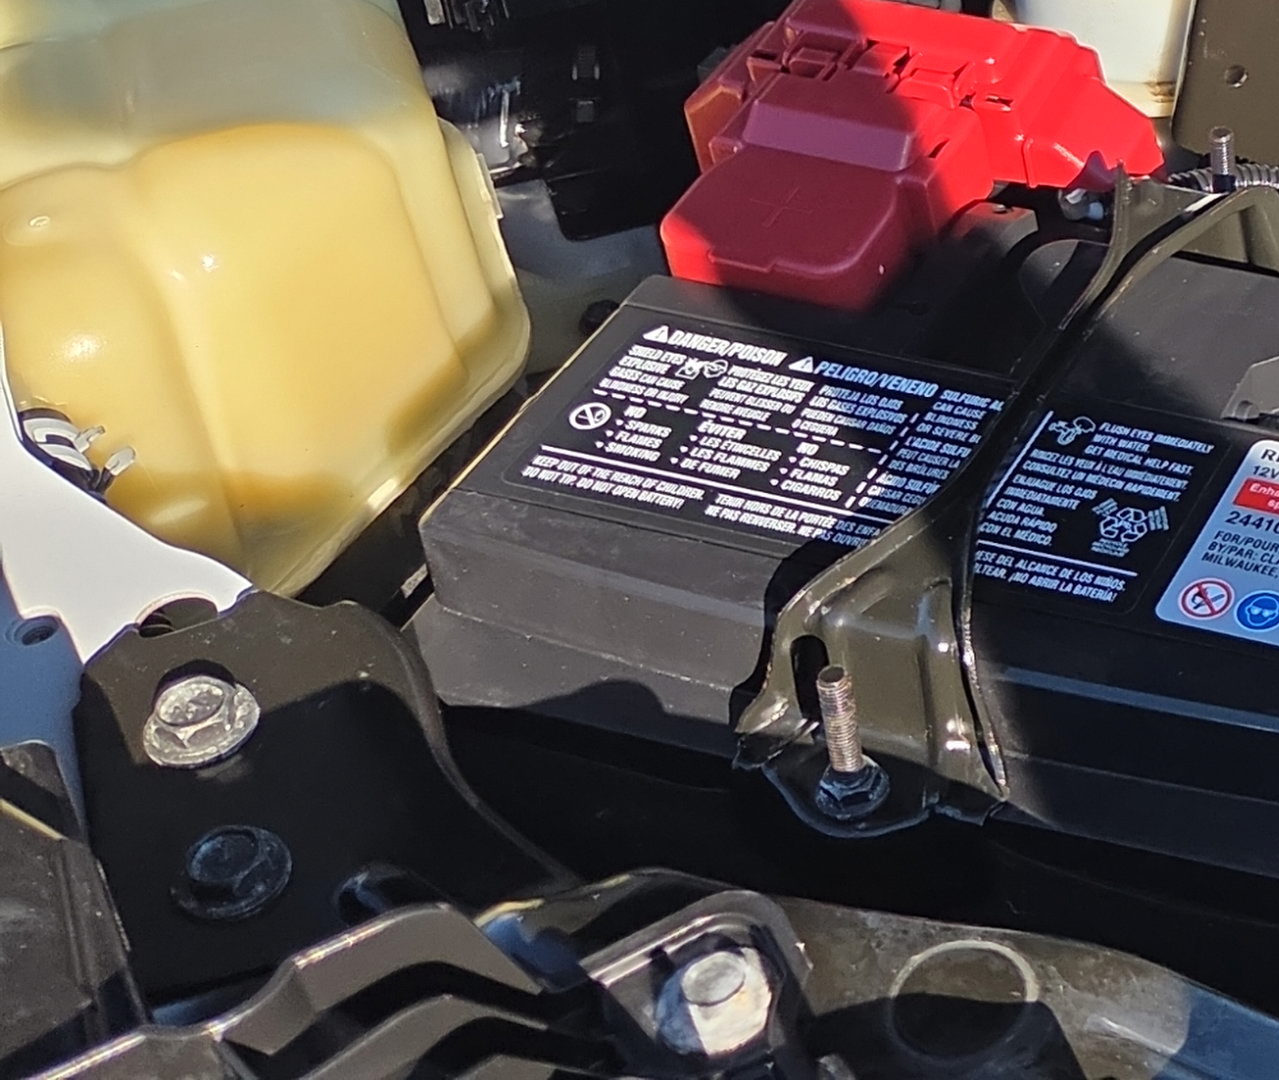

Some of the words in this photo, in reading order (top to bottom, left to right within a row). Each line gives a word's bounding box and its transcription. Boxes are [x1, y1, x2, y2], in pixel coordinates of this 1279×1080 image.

[627, 346, 662, 359] SHIELD
[665, 332, 785, 365] DANGER/POISON
[813, 362, 937, 397] PELIGRO/VENENO
[819, 385, 861, 400] PROTEJA
[859, 393, 879, 404] LOS
[878, 396, 902, 409] OJOS
[940, 390, 989, 407] SULFURIC
[623, 406, 646, 418] NO
[800, 407, 835, 421] PUEDEN
[834, 414, 868, 428] CAUSAR
[809, 396, 828, 407] LOS
[827, 400, 856, 412] GASES
[855, 405, 907, 423] EXPLOSIVOS
[933, 401, 953, 411] CAN
[954, 405, 984, 418] CAUSE
[624, 420, 672, 436] SPARKS
[697, 420, 747, 438] ÉVITER
[800, 421, 838, 435] CEGUERA
[924, 412, 977, 429] BLINDNESS
[614, 432, 662, 447] FLAMES
[916, 422, 932, 432] OR
[932, 426, 968, 440] SEVERE
[1092, 434, 1117, 446] WITH
[1098, 423, 1130, 436] FLUSH
[1129, 429, 1154, 440] EYES
[1152, 434, 1214, 452] IMMEDIATELY
[699, 434, 722, 447] LES
[796, 442, 819, 454] NO
[603, 442, 660, 460] SMOKING
[690, 447, 713, 459] LES
[712, 452, 770, 471] FLAMMES
[896, 448, 918, 459] PEUT
[917, 452, 948, 465] CAUSER
[948, 459, 960, 468] LA
[1084, 445, 1103, 456] GET
[1102, 449, 1144, 464] MEDICAL
[1143, 457, 1169, 469] HELP
[532, 455, 559, 467] KEEP
[556, 460, 579, 472] OUT
[576, 464, 593, 475] OF
[590, 468, 612, 479] THE
[609, 472, 644, 486] REACH
[641, 478, 657, 488] OF
[681, 459, 698, 469] DE
[697, 462, 740, 478] FUMER
[797, 457, 848, 474] CHISPAS
[1029, 450, 1059, 462] RINCEZ
[1057, 455, 1074, 465] LES
[1073, 458, 1095, 469] YEUX
[1101, 464, 1125, 475] L'EAU
[789, 468, 837, 485] FLAMAS
[1021, 461, 1072, 478] CONSULTEZ
[1070, 470, 1086, 481] UN
[1084, 473, 1125, 488] MÉDECIN
[521, 466, 540, 477] DO
[536, 470, 560, 481] NOT
[574, 478, 593, 488] DO
[590, 481, 613, 493] NOT
[610, 485, 640, 498] OPEN
[637, 491, 684, 508] BATTERY!
[780, 480, 841, 499] CIGARROS
[866, 484, 903, 500] CAUSAR
[1012, 475, 1056, 490] ENJUAGUE
[1056, 483, 1074, 494] LOS
[1073, 486, 1097, 498] OJOS
[713, 492, 745, 508] TENIR
[742, 499, 772, 514] HORS
[770, 504, 786, 517] DE
[784, 507, 800, 520] LA
[835, 518, 856, 532] DES
[996, 499, 1017, 509] CON
[704, 504, 721, 516] NE
[719, 508, 740, 520] PAS
[796, 524, 813, 536] NE
[812, 527, 833, 540] PAS
[987, 509, 1021, 524] ACUDA
[979, 522, 1001, 534] CON
[1000, 526, 1014, 536] EL
[1207, 541, 1260, 560] BY/PAR:
[994, 555, 1015, 567] DEL
[1014, 559, 1060, 576] ALCANCE
[1058, 567, 1074, 578] DE
[1072, 570, 1095, 582] LOS
[1028, 575, 1059, 589] ABRIR
[1058, 582, 1073, 592] LA
